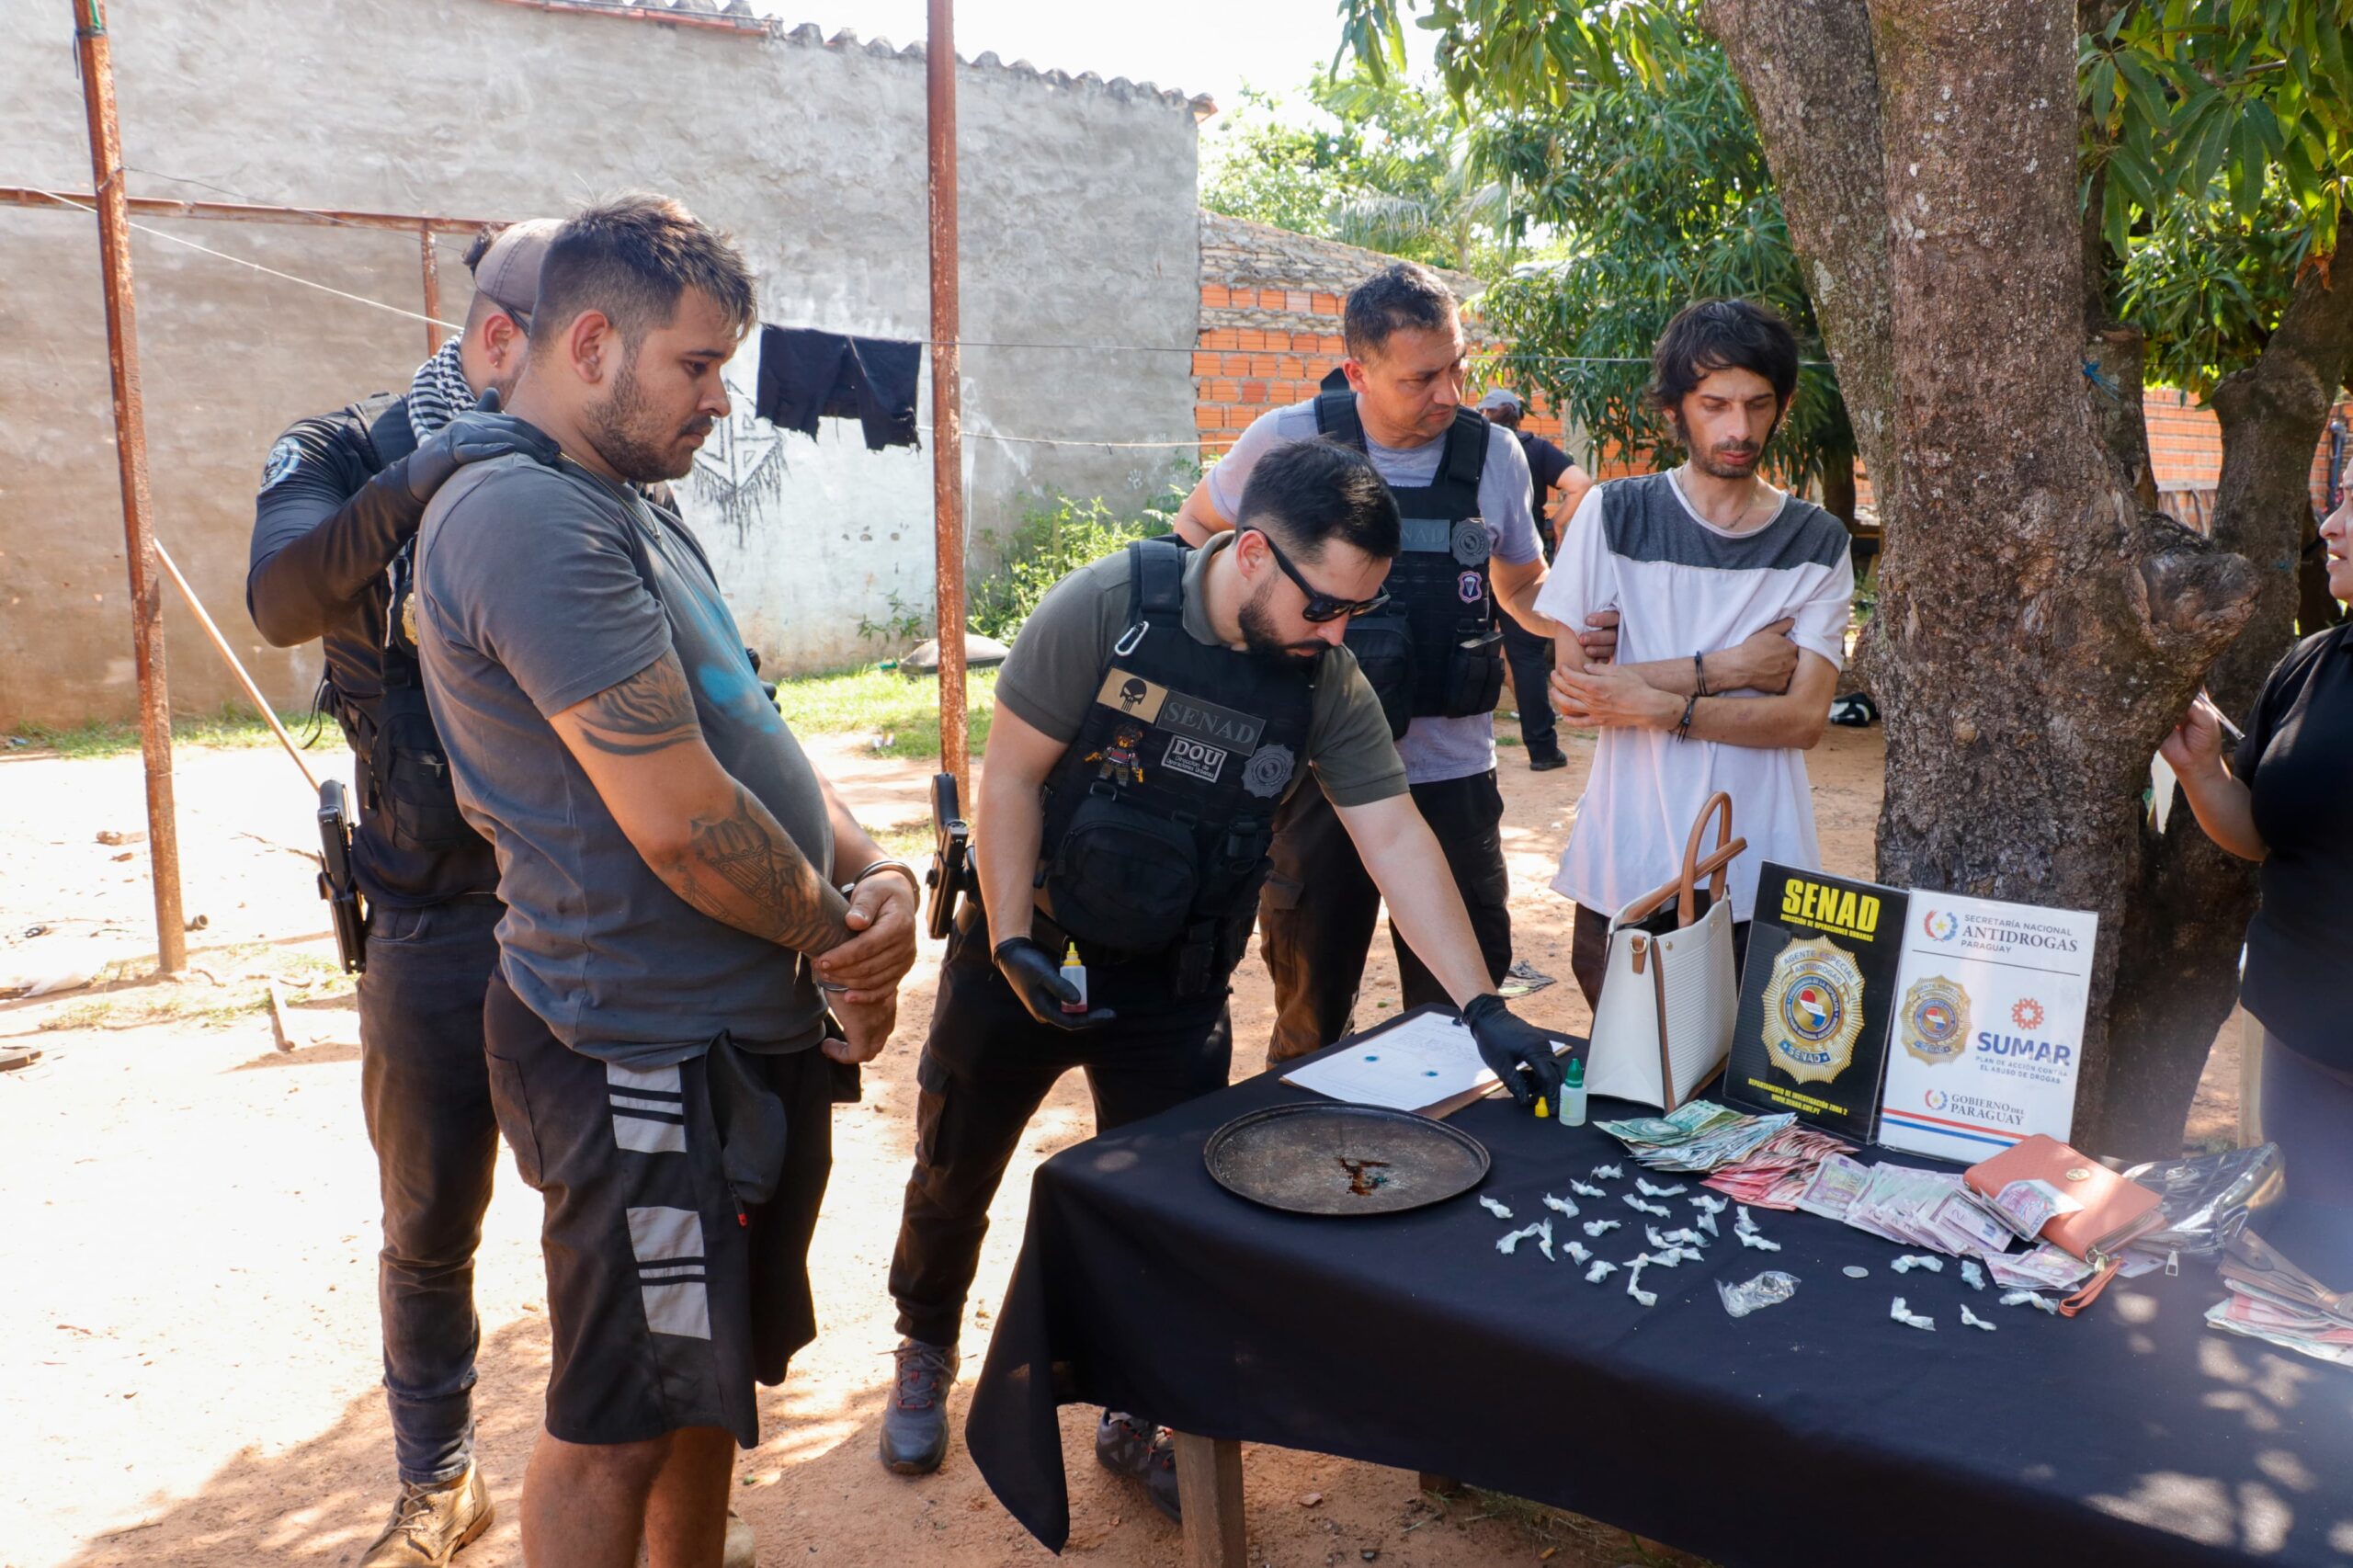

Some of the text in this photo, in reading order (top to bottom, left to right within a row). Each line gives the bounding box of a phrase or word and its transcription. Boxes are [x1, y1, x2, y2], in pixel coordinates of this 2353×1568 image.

[1165, 701, 1255, 744] SENAD
[1172, 740, 1222, 766] DOU
[1782, 879, 1881, 933] SENAD
[1964, 915, 2072, 936] SECRETARÍA NACIONAL
[1961, 939, 2011, 953] PARAGUAY
[1962, 926, 2078, 952] ANTIDROGAS
[1784, 950, 1855, 982] AGENTE ESPECIAL
[1795, 963, 1842, 985] ANTIDROGAS
[1789, 1046, 1821, 1062] SENAD
[1975, 1055, 1994, 1063] PLAN
[1977, 1031, 2071, 1066] SUMAR
[1991, 1065, 2016, 1075] ABUSO
[2029, 1074, 2061, 1084] DROGAS
[1843, 1108, 1848, 1116] 2
[1951, 1094, 2010, 1111] GOBIERNO
[1950, 1103, 2025, 1126] PARAGUAY
